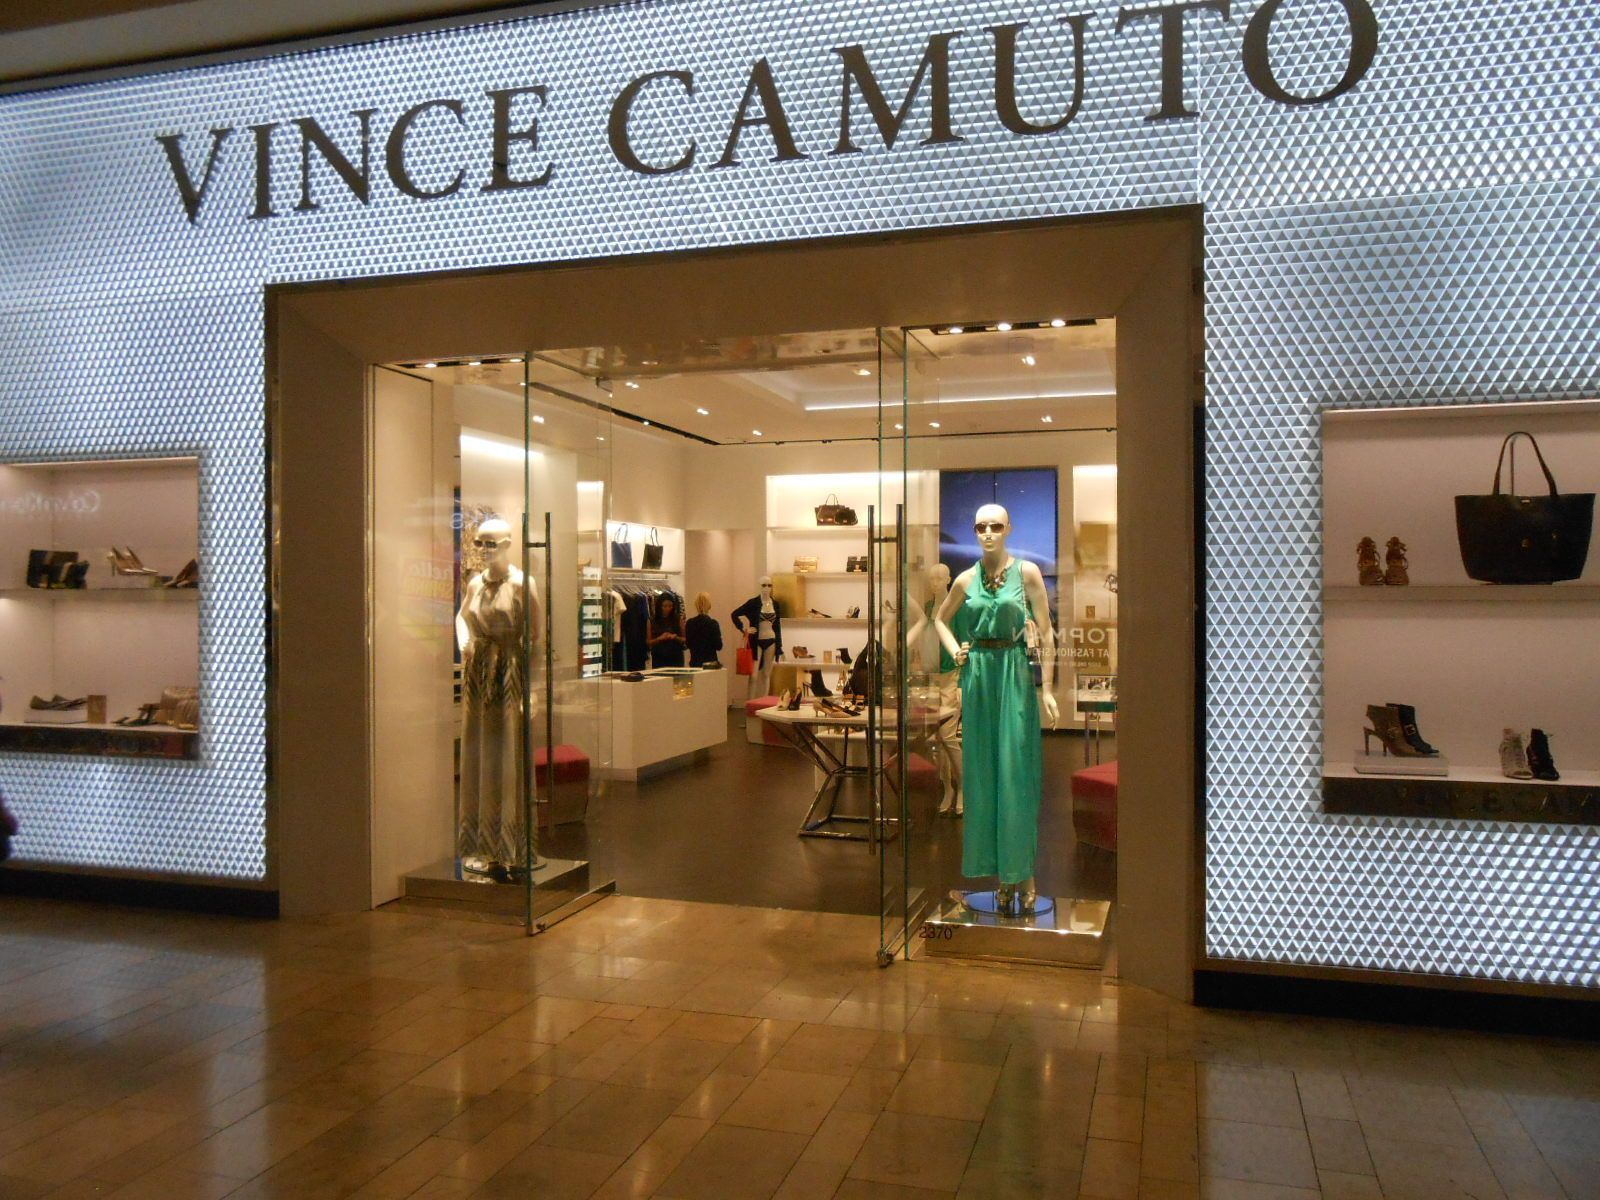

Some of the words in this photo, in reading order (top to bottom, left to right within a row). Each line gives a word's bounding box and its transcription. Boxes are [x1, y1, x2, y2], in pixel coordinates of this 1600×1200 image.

[155, 84, 555, 224] VINCE
[608, 0, 1379, 175] CAMUTO
[919, 925, 953, 940] 2370
